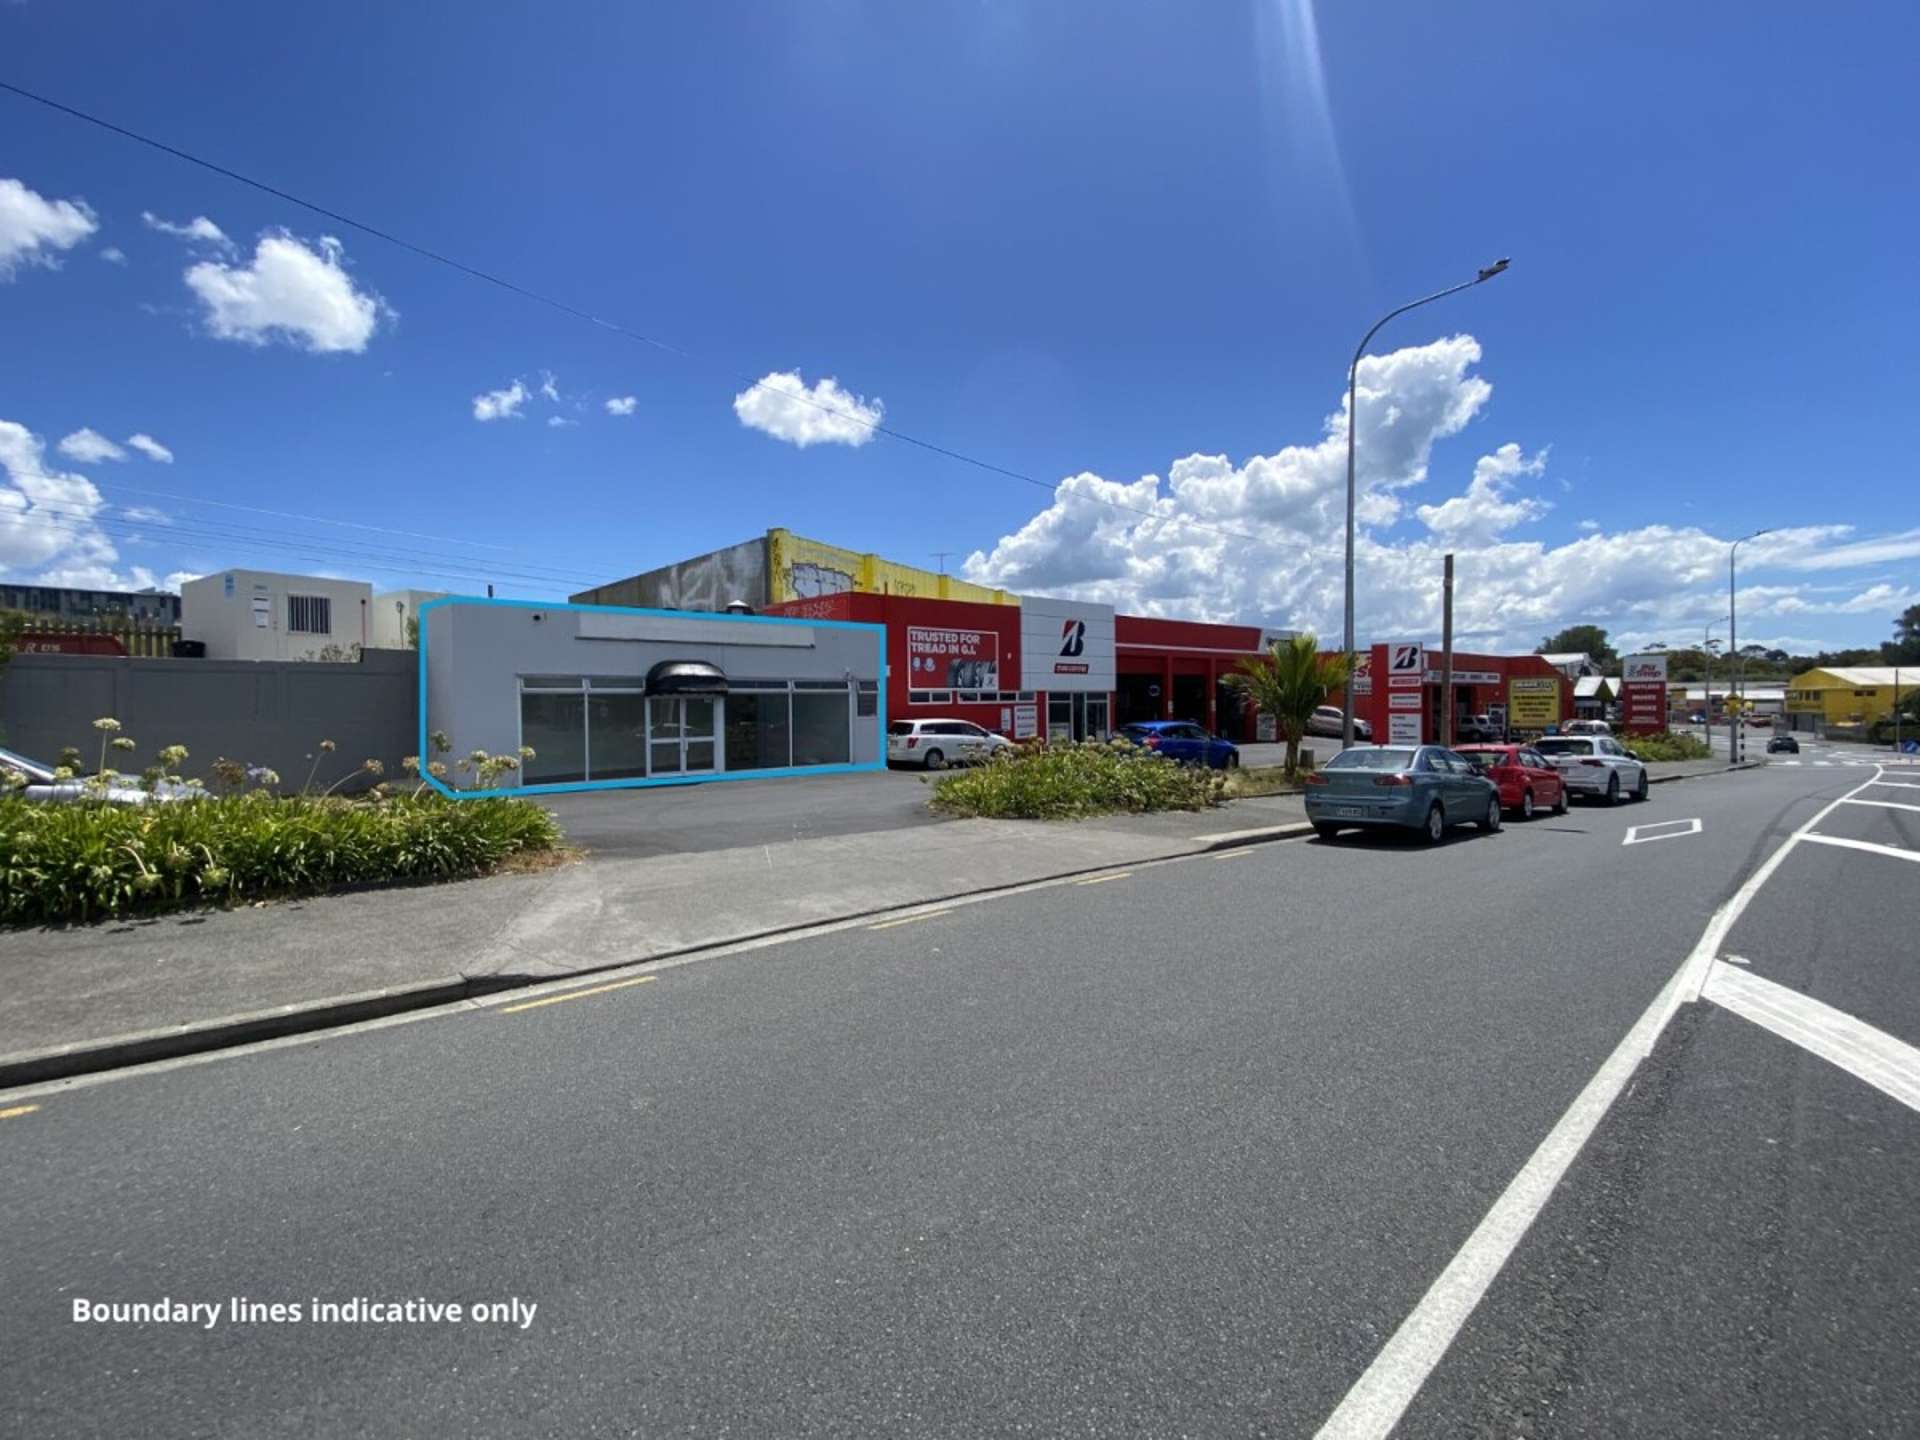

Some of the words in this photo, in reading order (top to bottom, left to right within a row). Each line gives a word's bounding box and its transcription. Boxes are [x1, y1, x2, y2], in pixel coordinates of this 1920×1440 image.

[911, 630, 958, 643] TRUSTED
[960, 633, 980, 645] FOR
[911, 642, 946, 654] TREAD
[948, 644, 959, 655] IN
